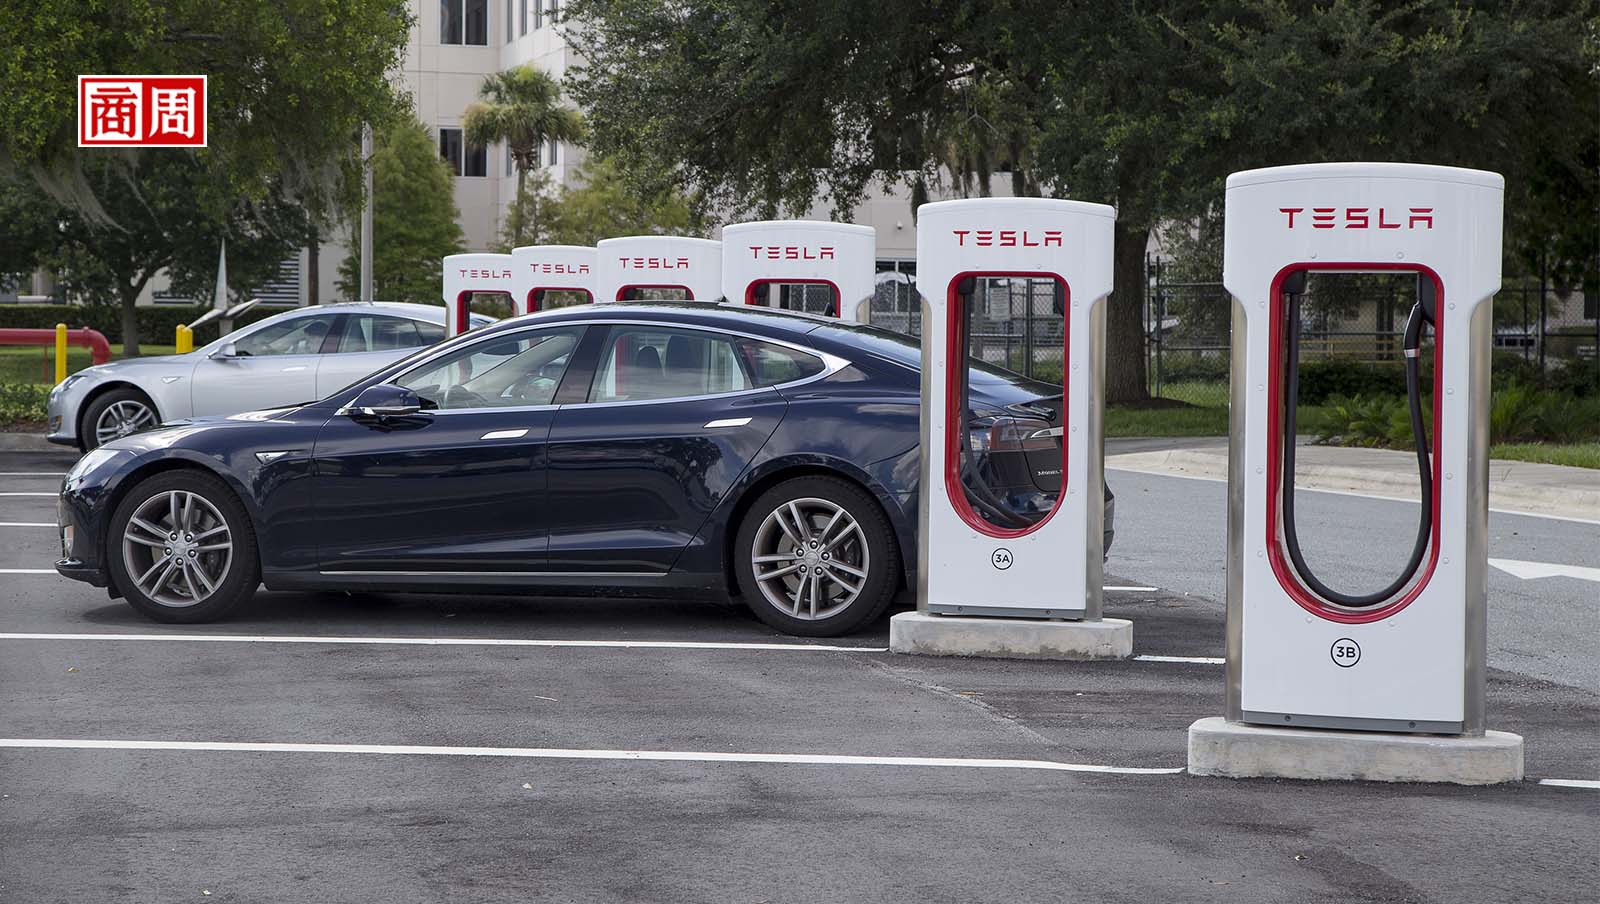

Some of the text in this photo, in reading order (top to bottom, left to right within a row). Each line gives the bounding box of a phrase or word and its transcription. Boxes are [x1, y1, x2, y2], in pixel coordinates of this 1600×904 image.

[1279, 207, 1434, 229] TESLA
[953, 230, 1063, 248] TESLA
[749, 245, 835, 260] TESLA
[529, 264, 590, 274] TESLA
[619, 257, 690, 269] TESLA
[459, 269, 512, 279] TESLA
[995, 554, 1010, 563] 3A
[1336, 646, 1356, 658] 3B
